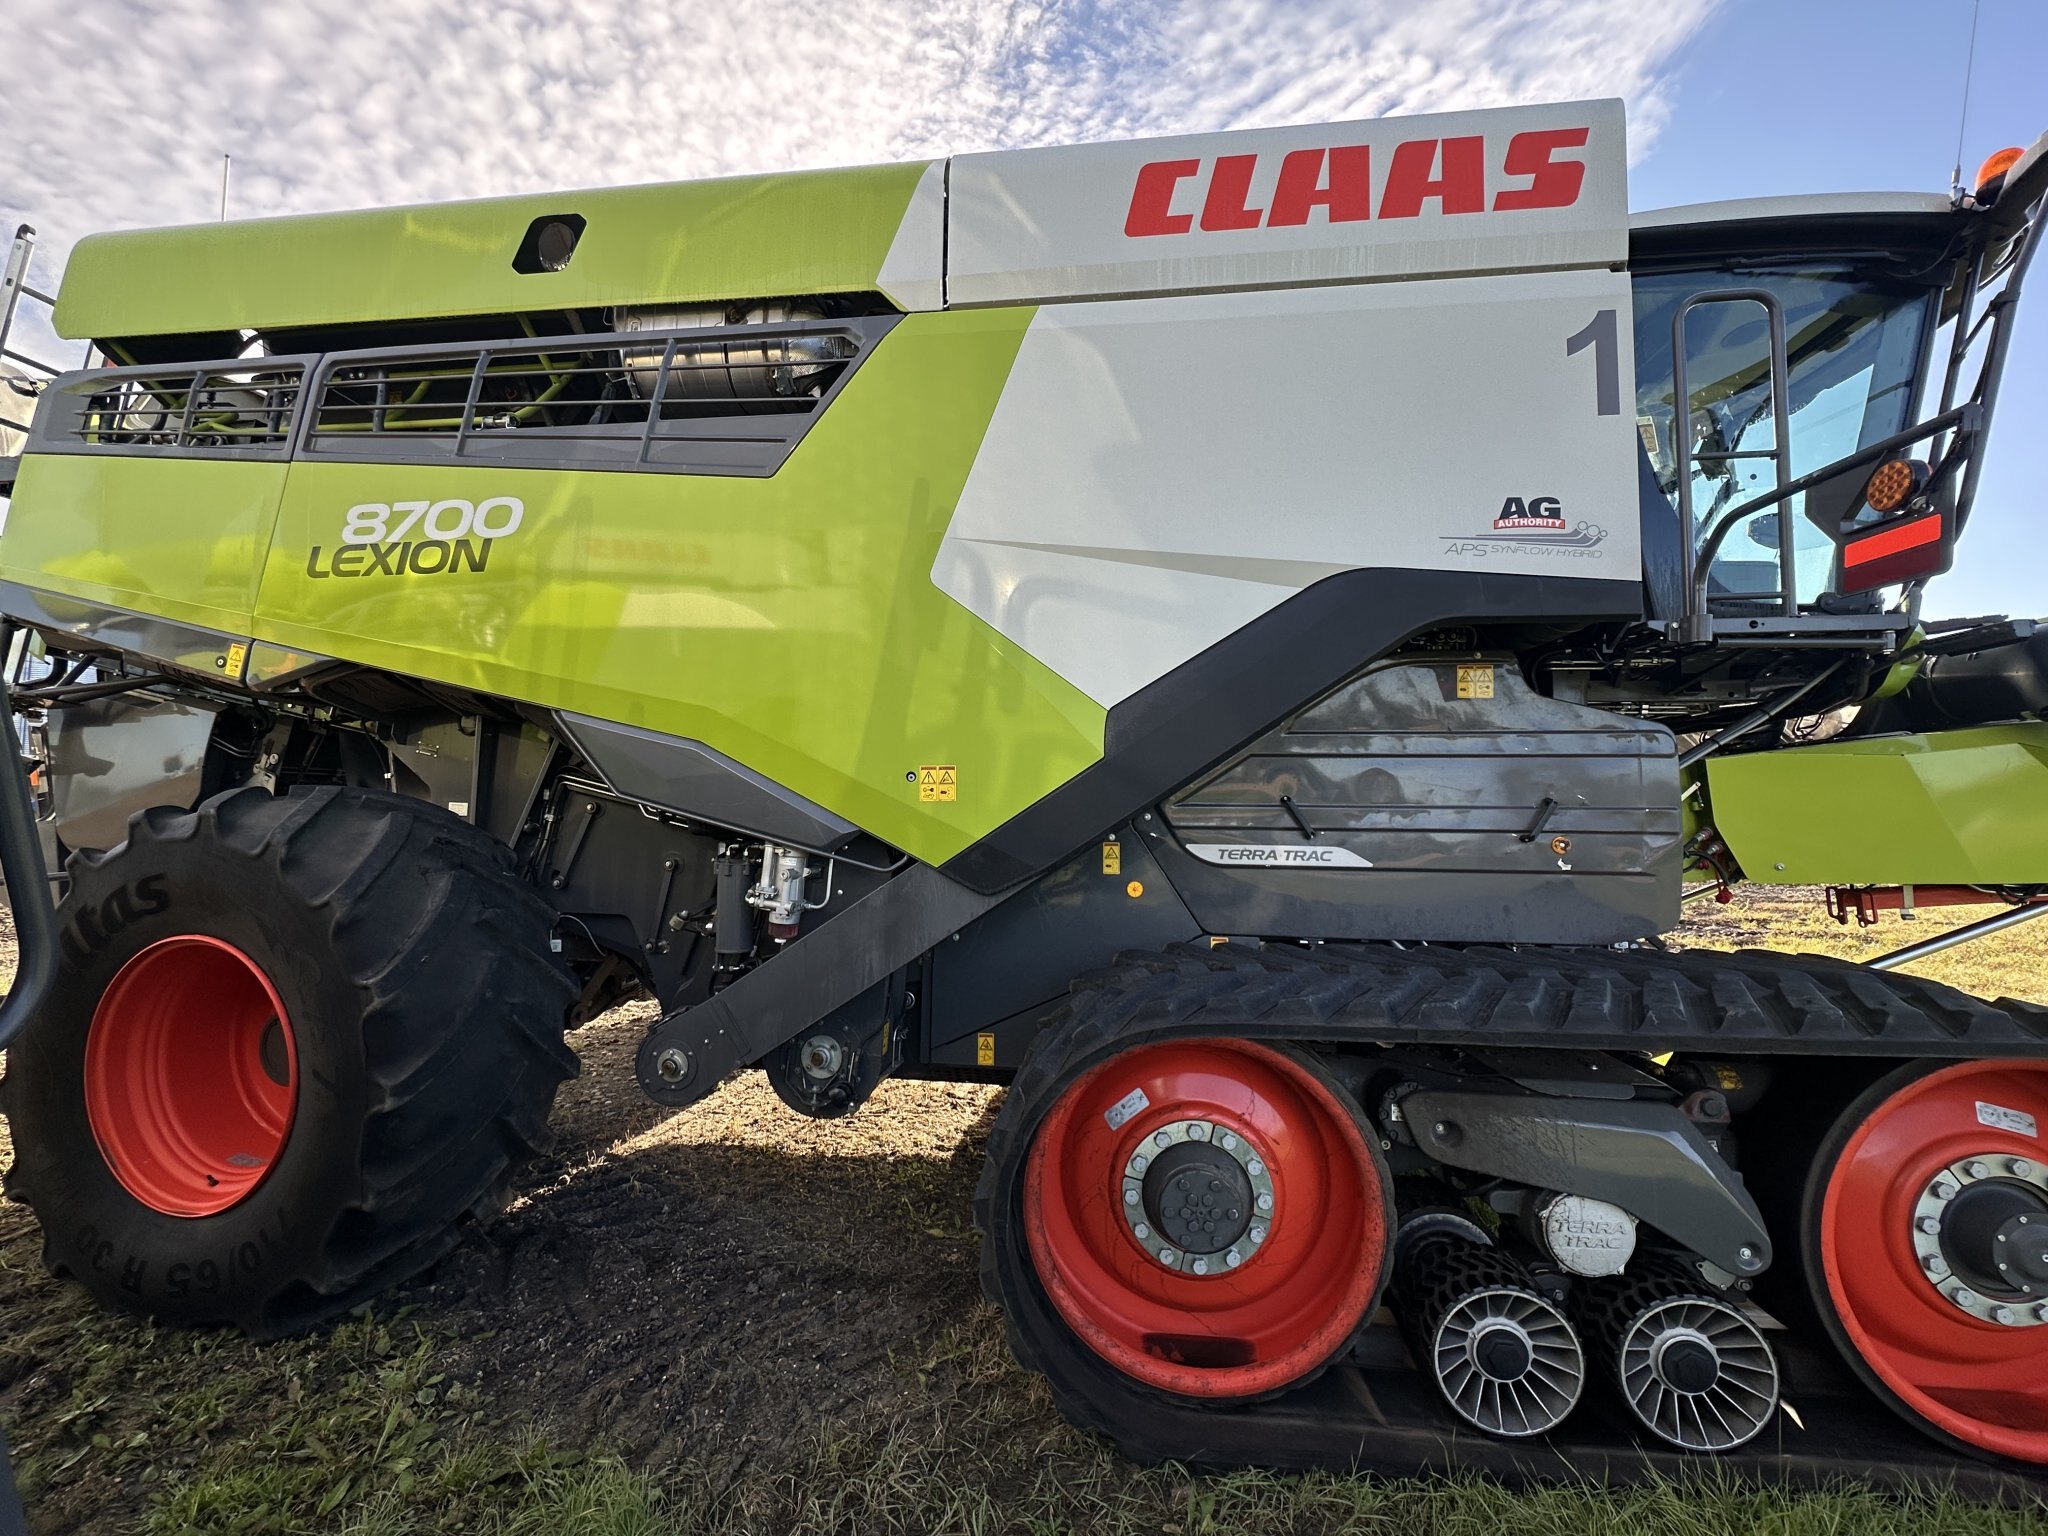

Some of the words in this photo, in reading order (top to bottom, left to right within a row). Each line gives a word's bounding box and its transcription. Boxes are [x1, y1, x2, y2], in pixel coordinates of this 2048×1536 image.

[1124, 127, 1590, 238] CLAAS
[1566, 309, 1621, 416] 1
[1498, 496, 1561, 520] AG
[341, 496, 525, 545] 8700
[1497, 518, 1562, 528] AUTHORITY
[306, 538, 493, 579] LEXION
[1444, 543, 1489, 557] APS
[1490, 545, 1556, 556] SYNFLOW
[1556, 548, 1603, 559] HYBRID
[1218, 848, 1278, 861] TERRA
[1284, 850, 1333, 862] TRAC
[1555, 1219, 1625, 1235] TERRA
[1564, 1235, 1622, 1249] TRAC
